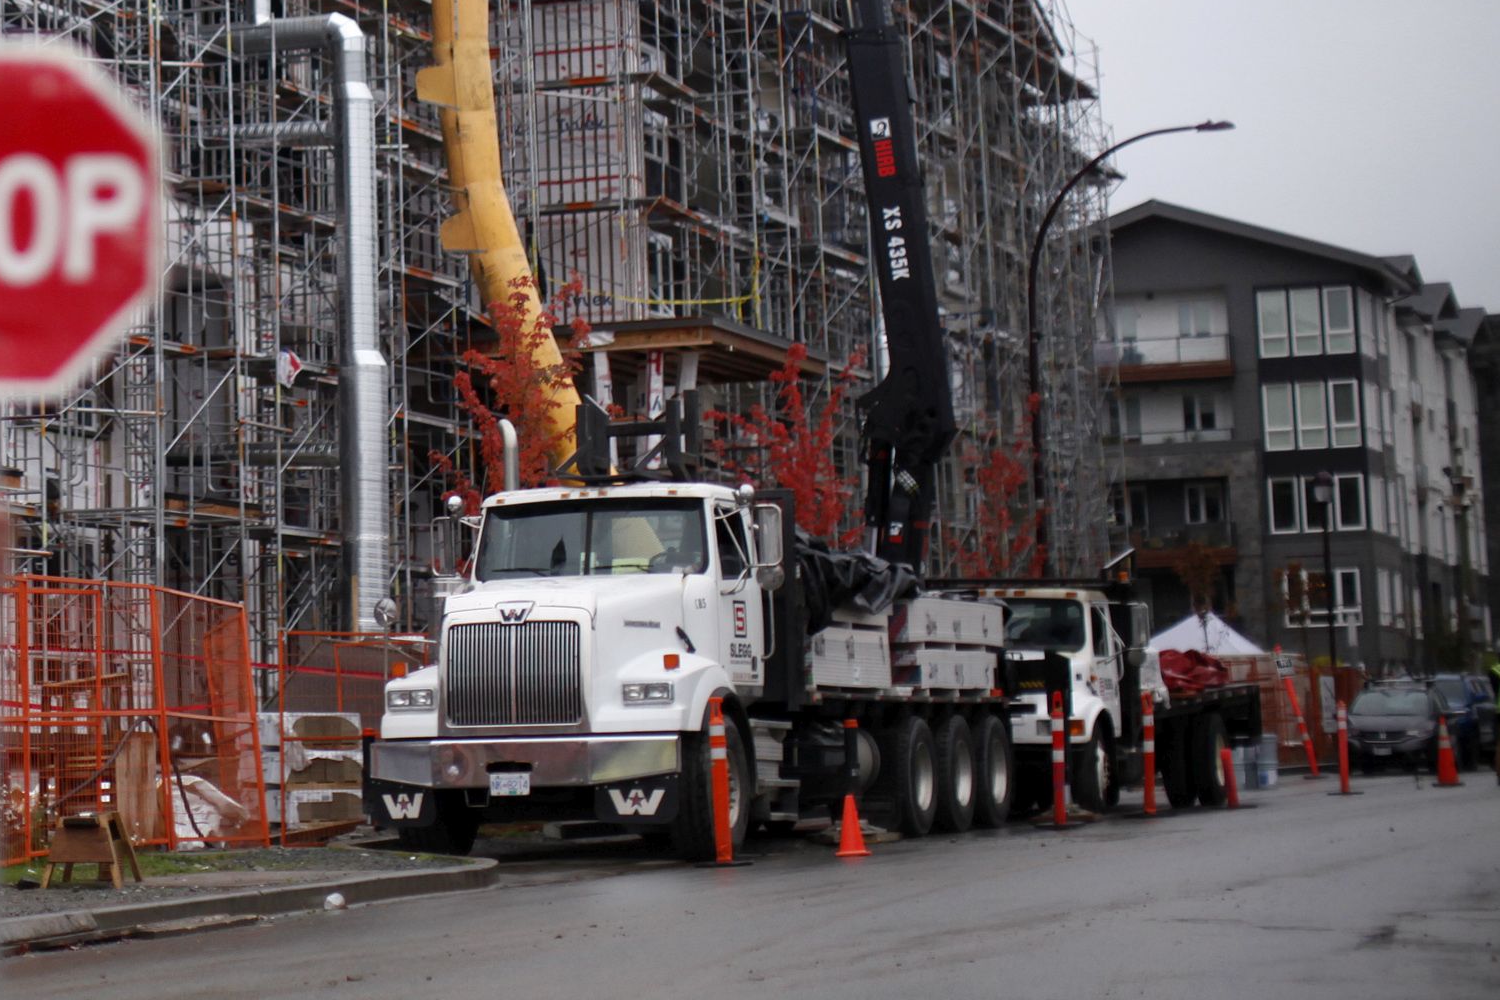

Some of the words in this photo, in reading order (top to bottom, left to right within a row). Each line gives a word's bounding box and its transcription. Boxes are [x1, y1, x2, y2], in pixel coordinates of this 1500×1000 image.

[874, 139, 896, 178] HIAB
[882, 206, 902, 231] XS
[887, 236, 910, 281] 435K
